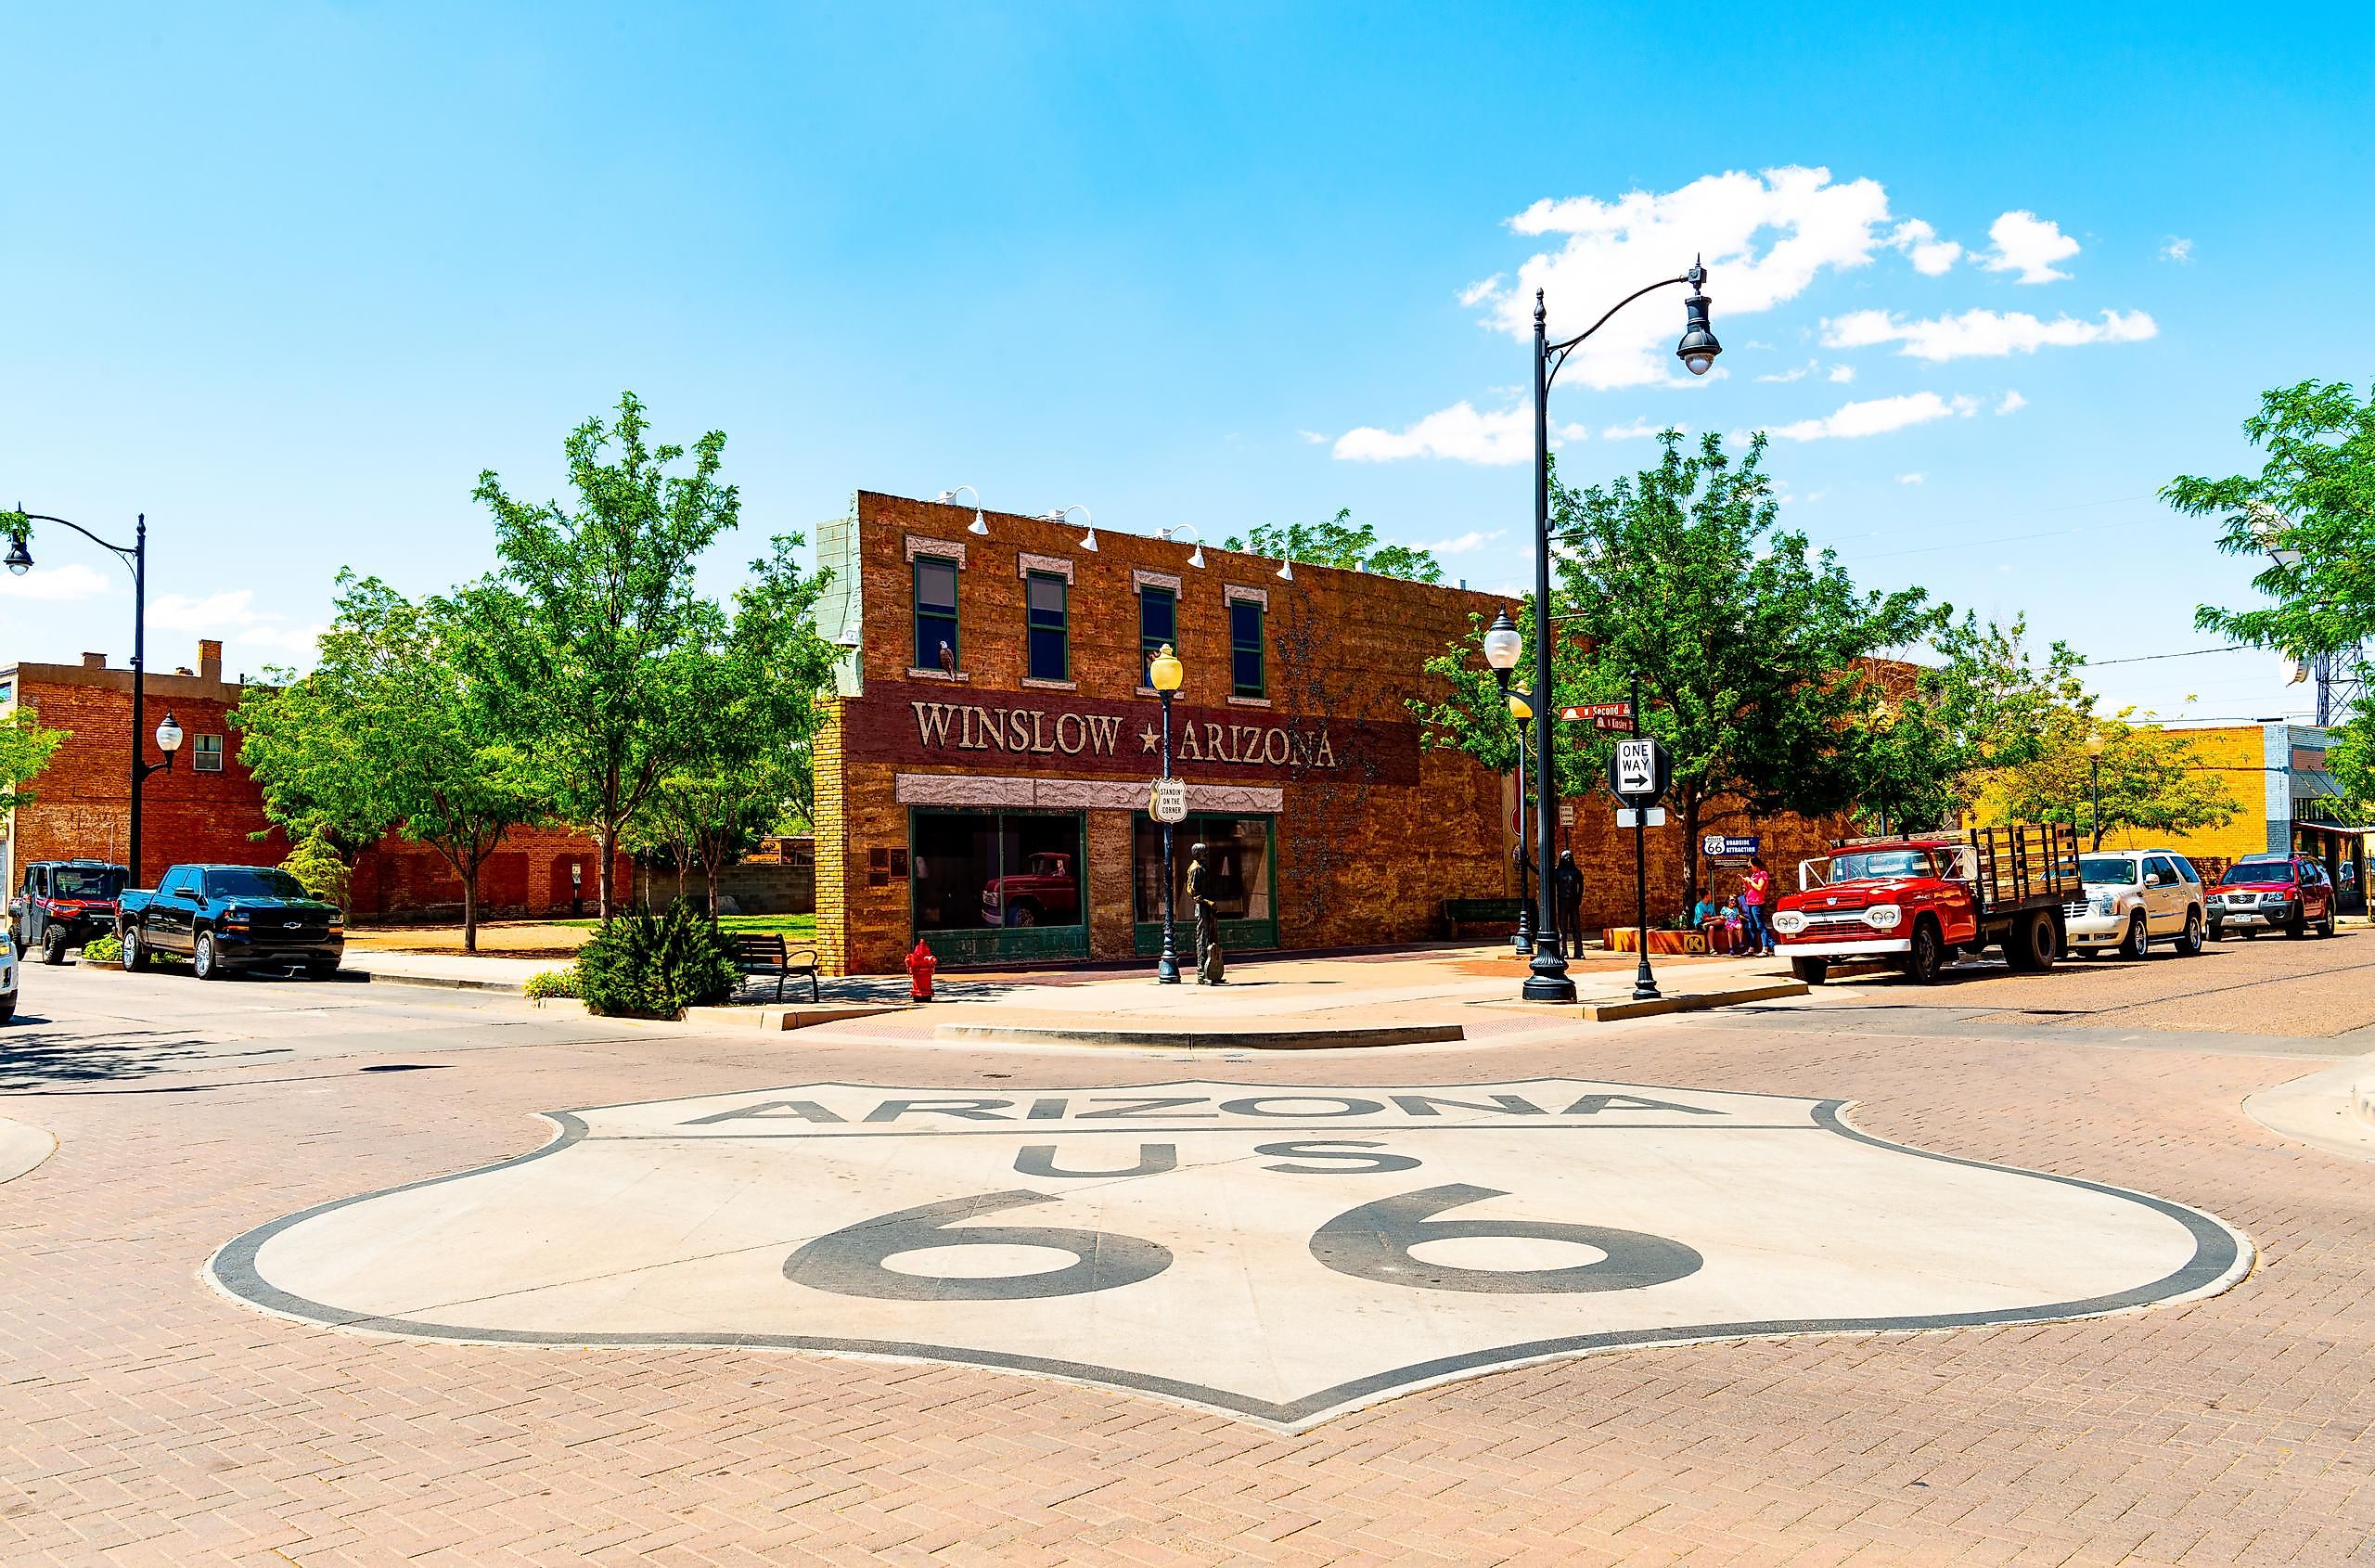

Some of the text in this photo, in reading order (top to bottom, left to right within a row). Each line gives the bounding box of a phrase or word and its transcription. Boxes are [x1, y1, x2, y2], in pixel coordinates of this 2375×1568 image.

[1593, 705, 1619, 715] Second
[1611, 718, 1627, 729] Kinsley
[910, 700, 1336, 768] WINSLOW ARIZONA
[1623, 745, 1648, 757] ONE
[1622, 758, 1649, 771] WAY
[1708, 842, 1722, 853] 66
[1689, 937, 1701, 949] K
[674, 1094, 1733, 1125] ARIZONA
[781, 1182, 1704, 1301] 66
